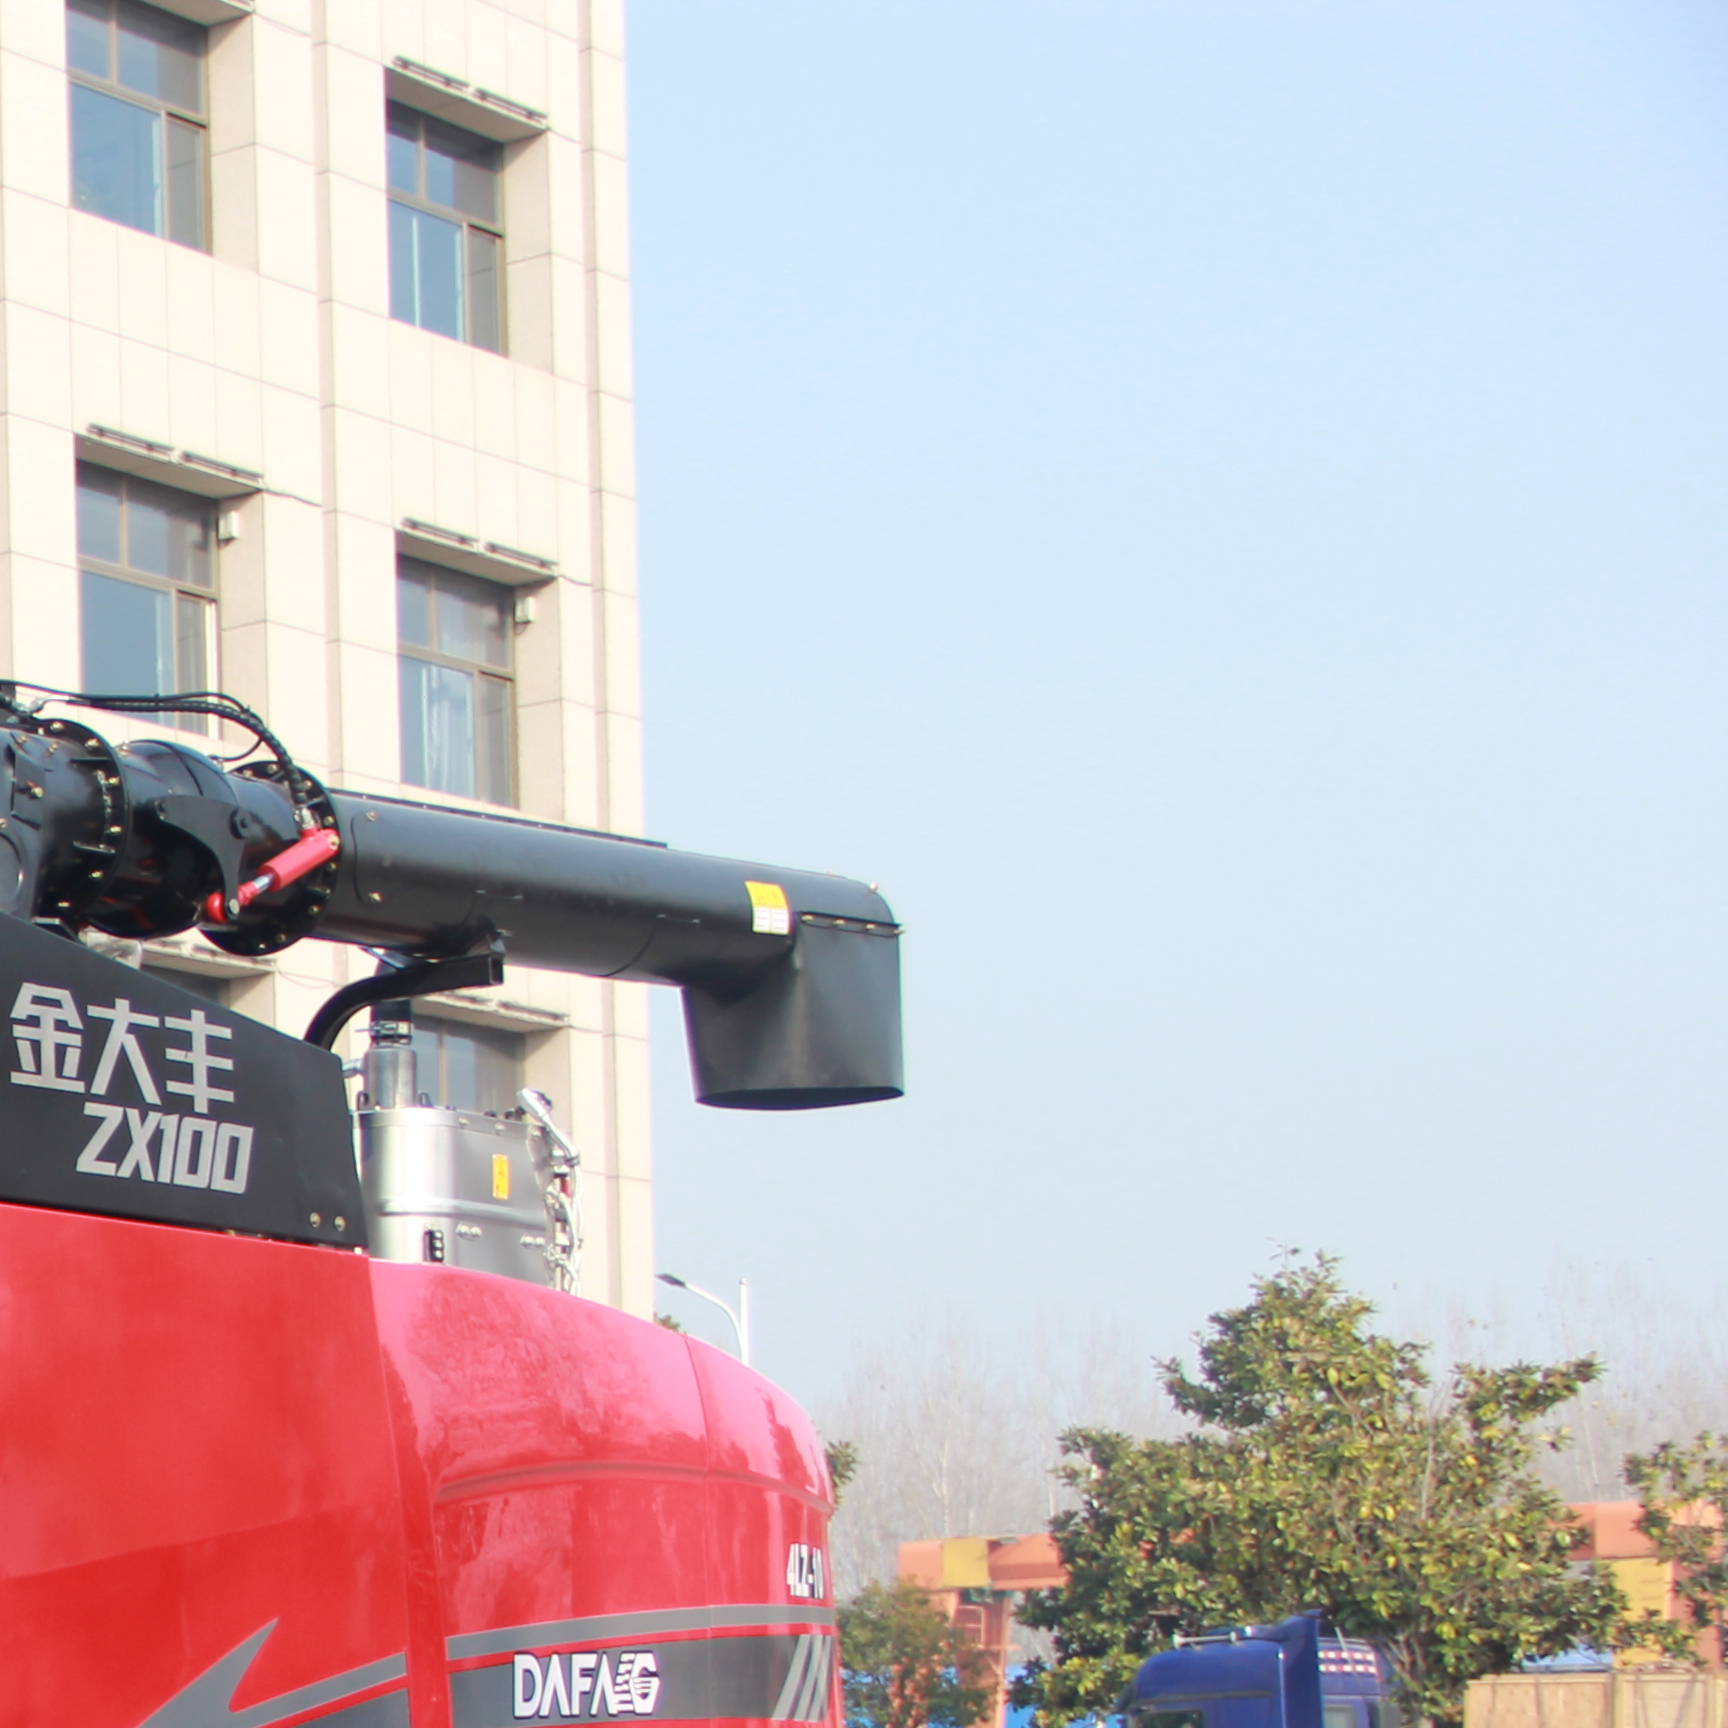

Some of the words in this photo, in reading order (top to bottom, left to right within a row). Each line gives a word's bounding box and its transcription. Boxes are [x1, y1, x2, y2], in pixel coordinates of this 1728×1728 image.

[9, 982, 235, 1114] 金大丰
[76, 1101, 254, 1194] ZX100
[787, 1543, 824, 1600] 4LZ-10
